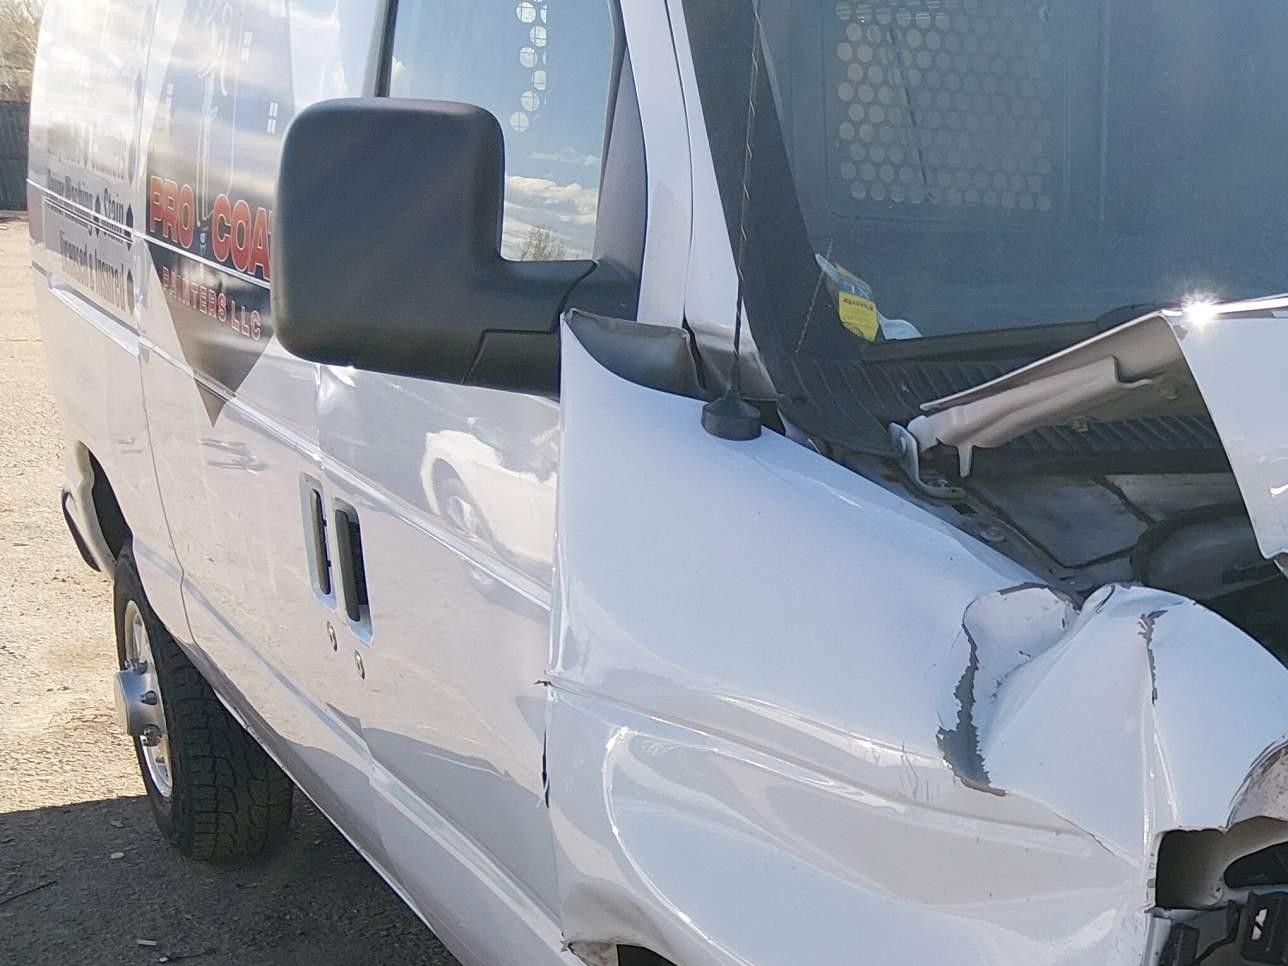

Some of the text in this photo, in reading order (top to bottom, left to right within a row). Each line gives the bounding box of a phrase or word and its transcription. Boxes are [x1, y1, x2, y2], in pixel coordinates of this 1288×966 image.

[103, 187, 125, 244] Stain
[150, 174, 273, 282] PRO COA
[162, 265, 262, 342] PAINTERS LLC
